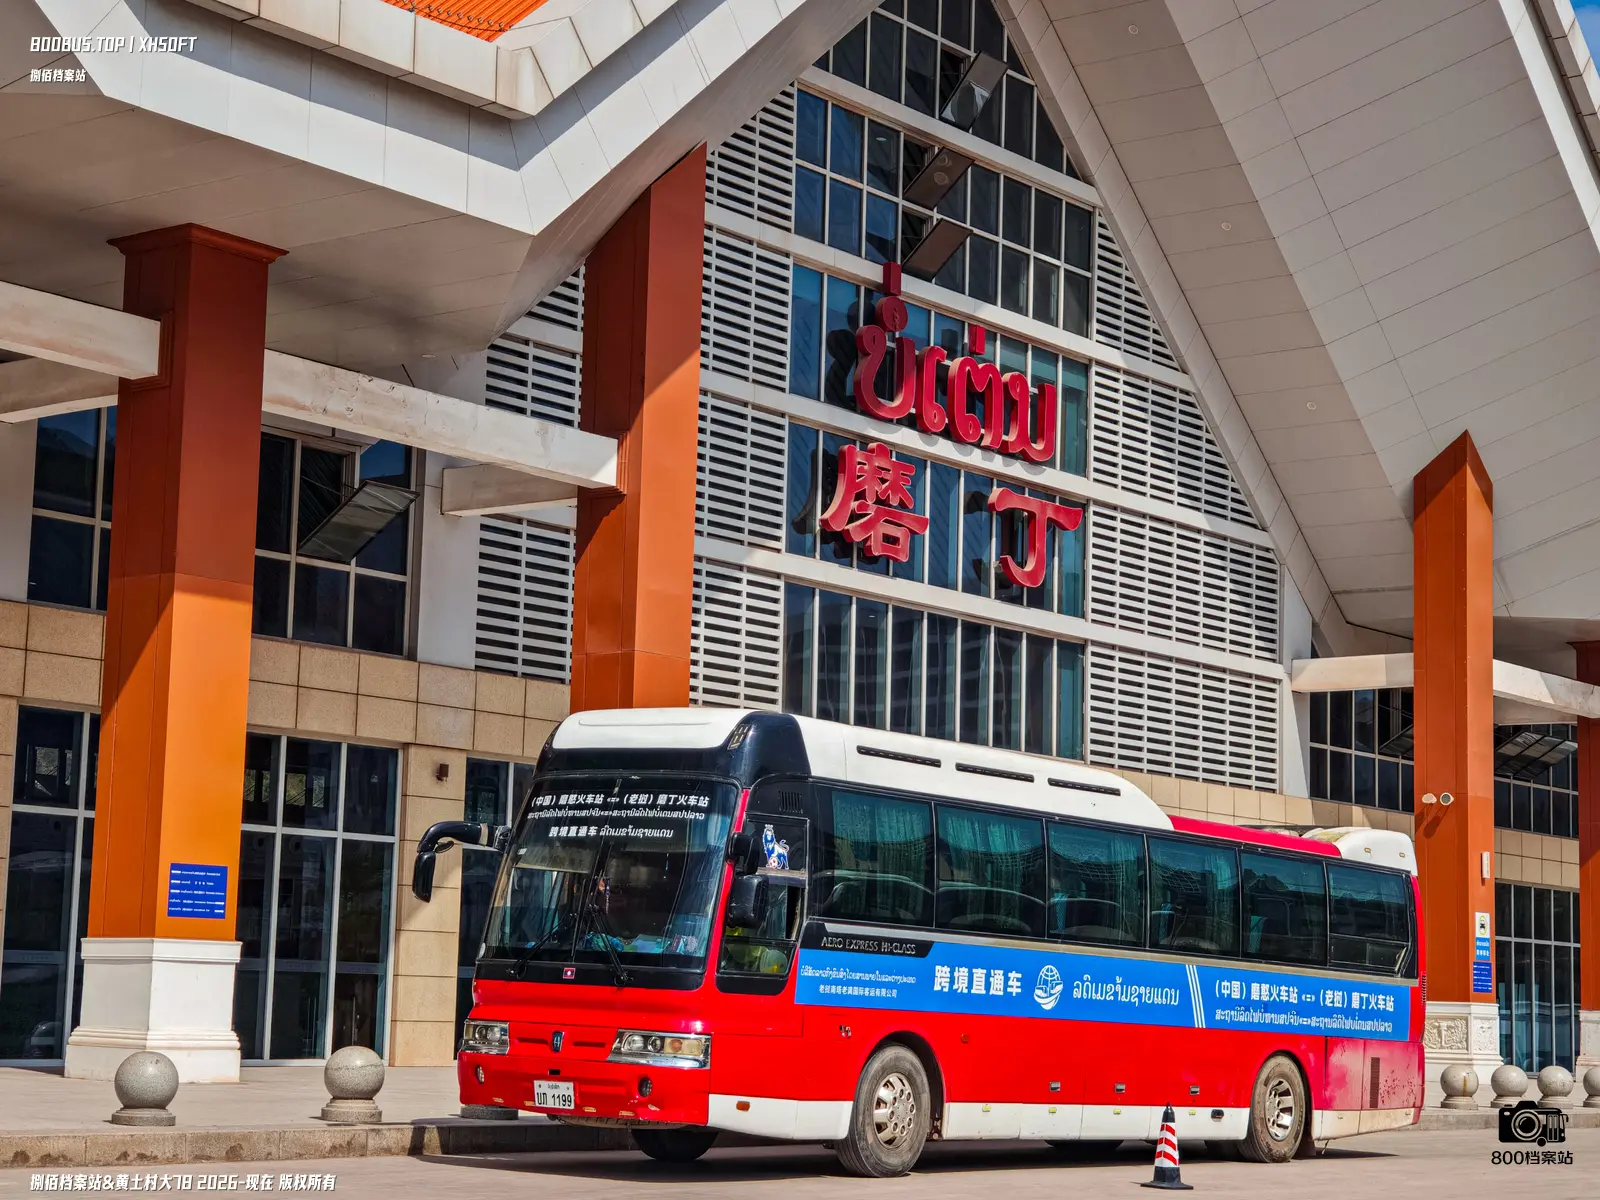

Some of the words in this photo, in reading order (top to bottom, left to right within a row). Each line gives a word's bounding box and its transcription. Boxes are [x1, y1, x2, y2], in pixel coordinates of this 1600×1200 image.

[548, 825, 598, 837] 跨境直通车
[820, 936, 843, 949] AERO
[845, 939, 879, 952] EXPRESS
[933, 965, 1023, 996] 跨境直通车
[552, 1093, 572, 1107] 1199
